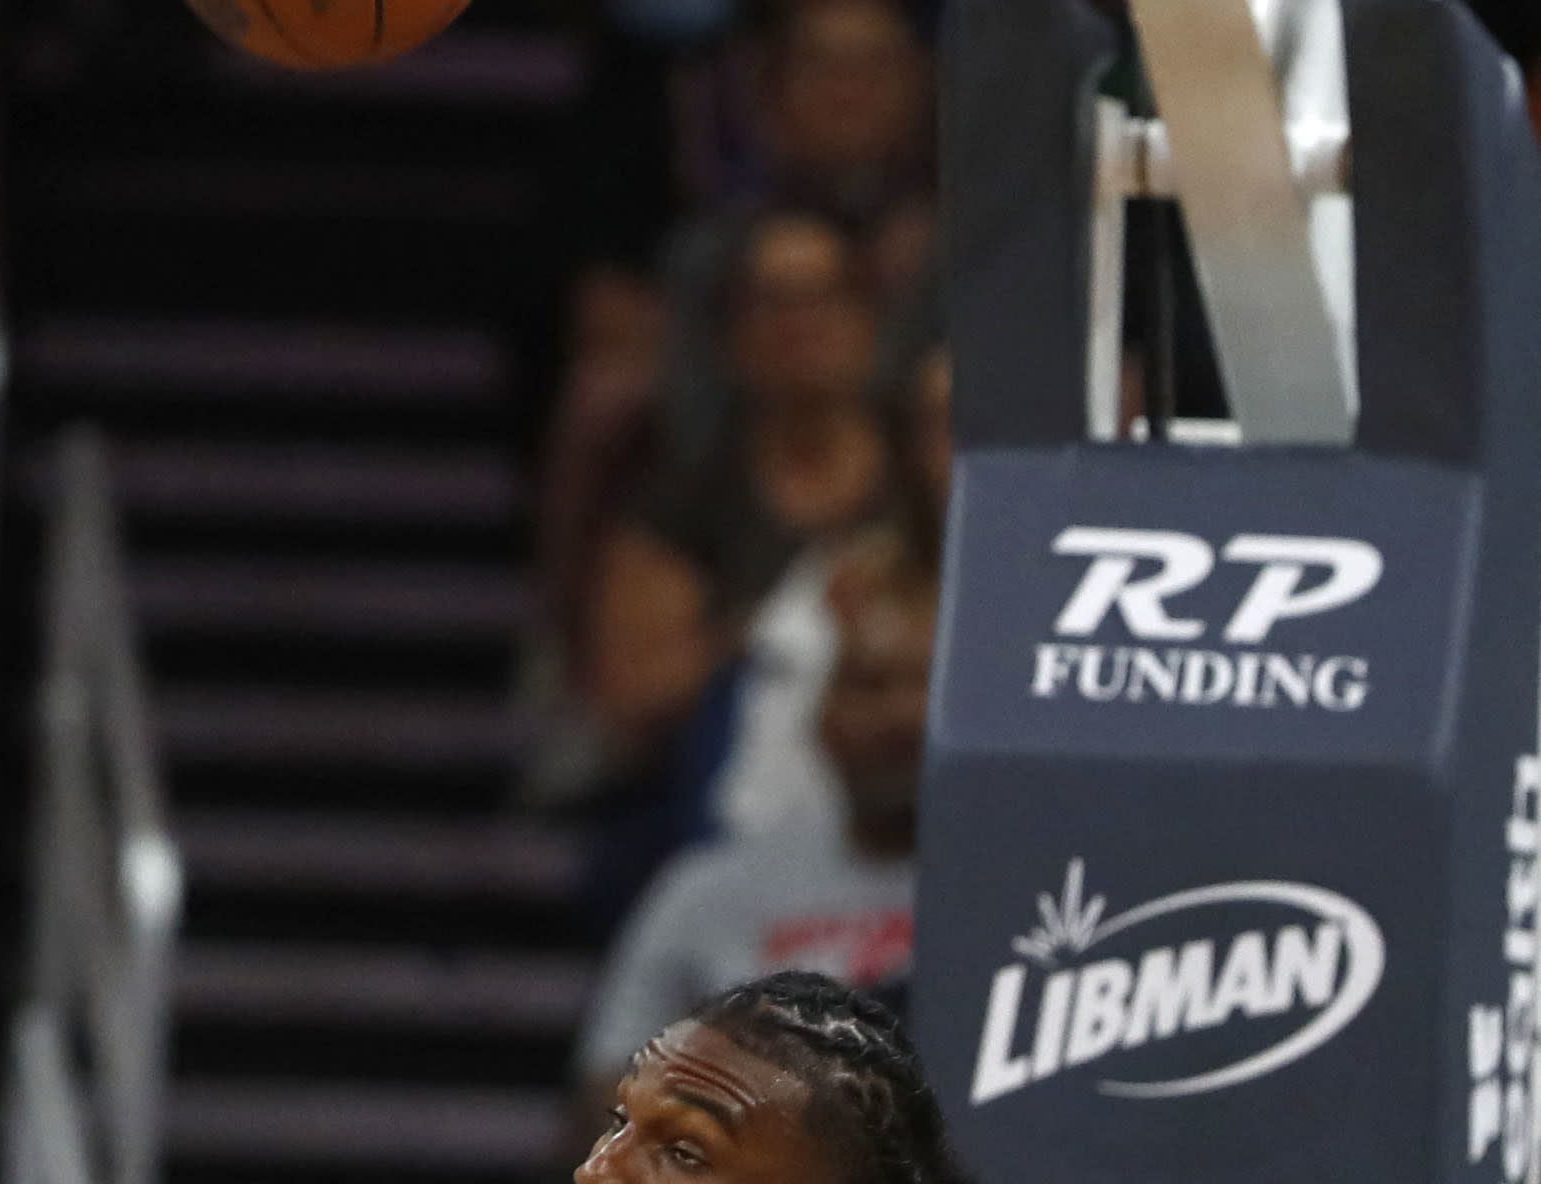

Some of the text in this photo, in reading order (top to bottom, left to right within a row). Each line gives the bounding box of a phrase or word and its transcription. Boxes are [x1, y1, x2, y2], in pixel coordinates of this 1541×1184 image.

[1050, 524, 1385, 644] RP
[1031, 642, 1369, 712] FUNDING
[970, 918, 1341, 1107] LIBMAN
